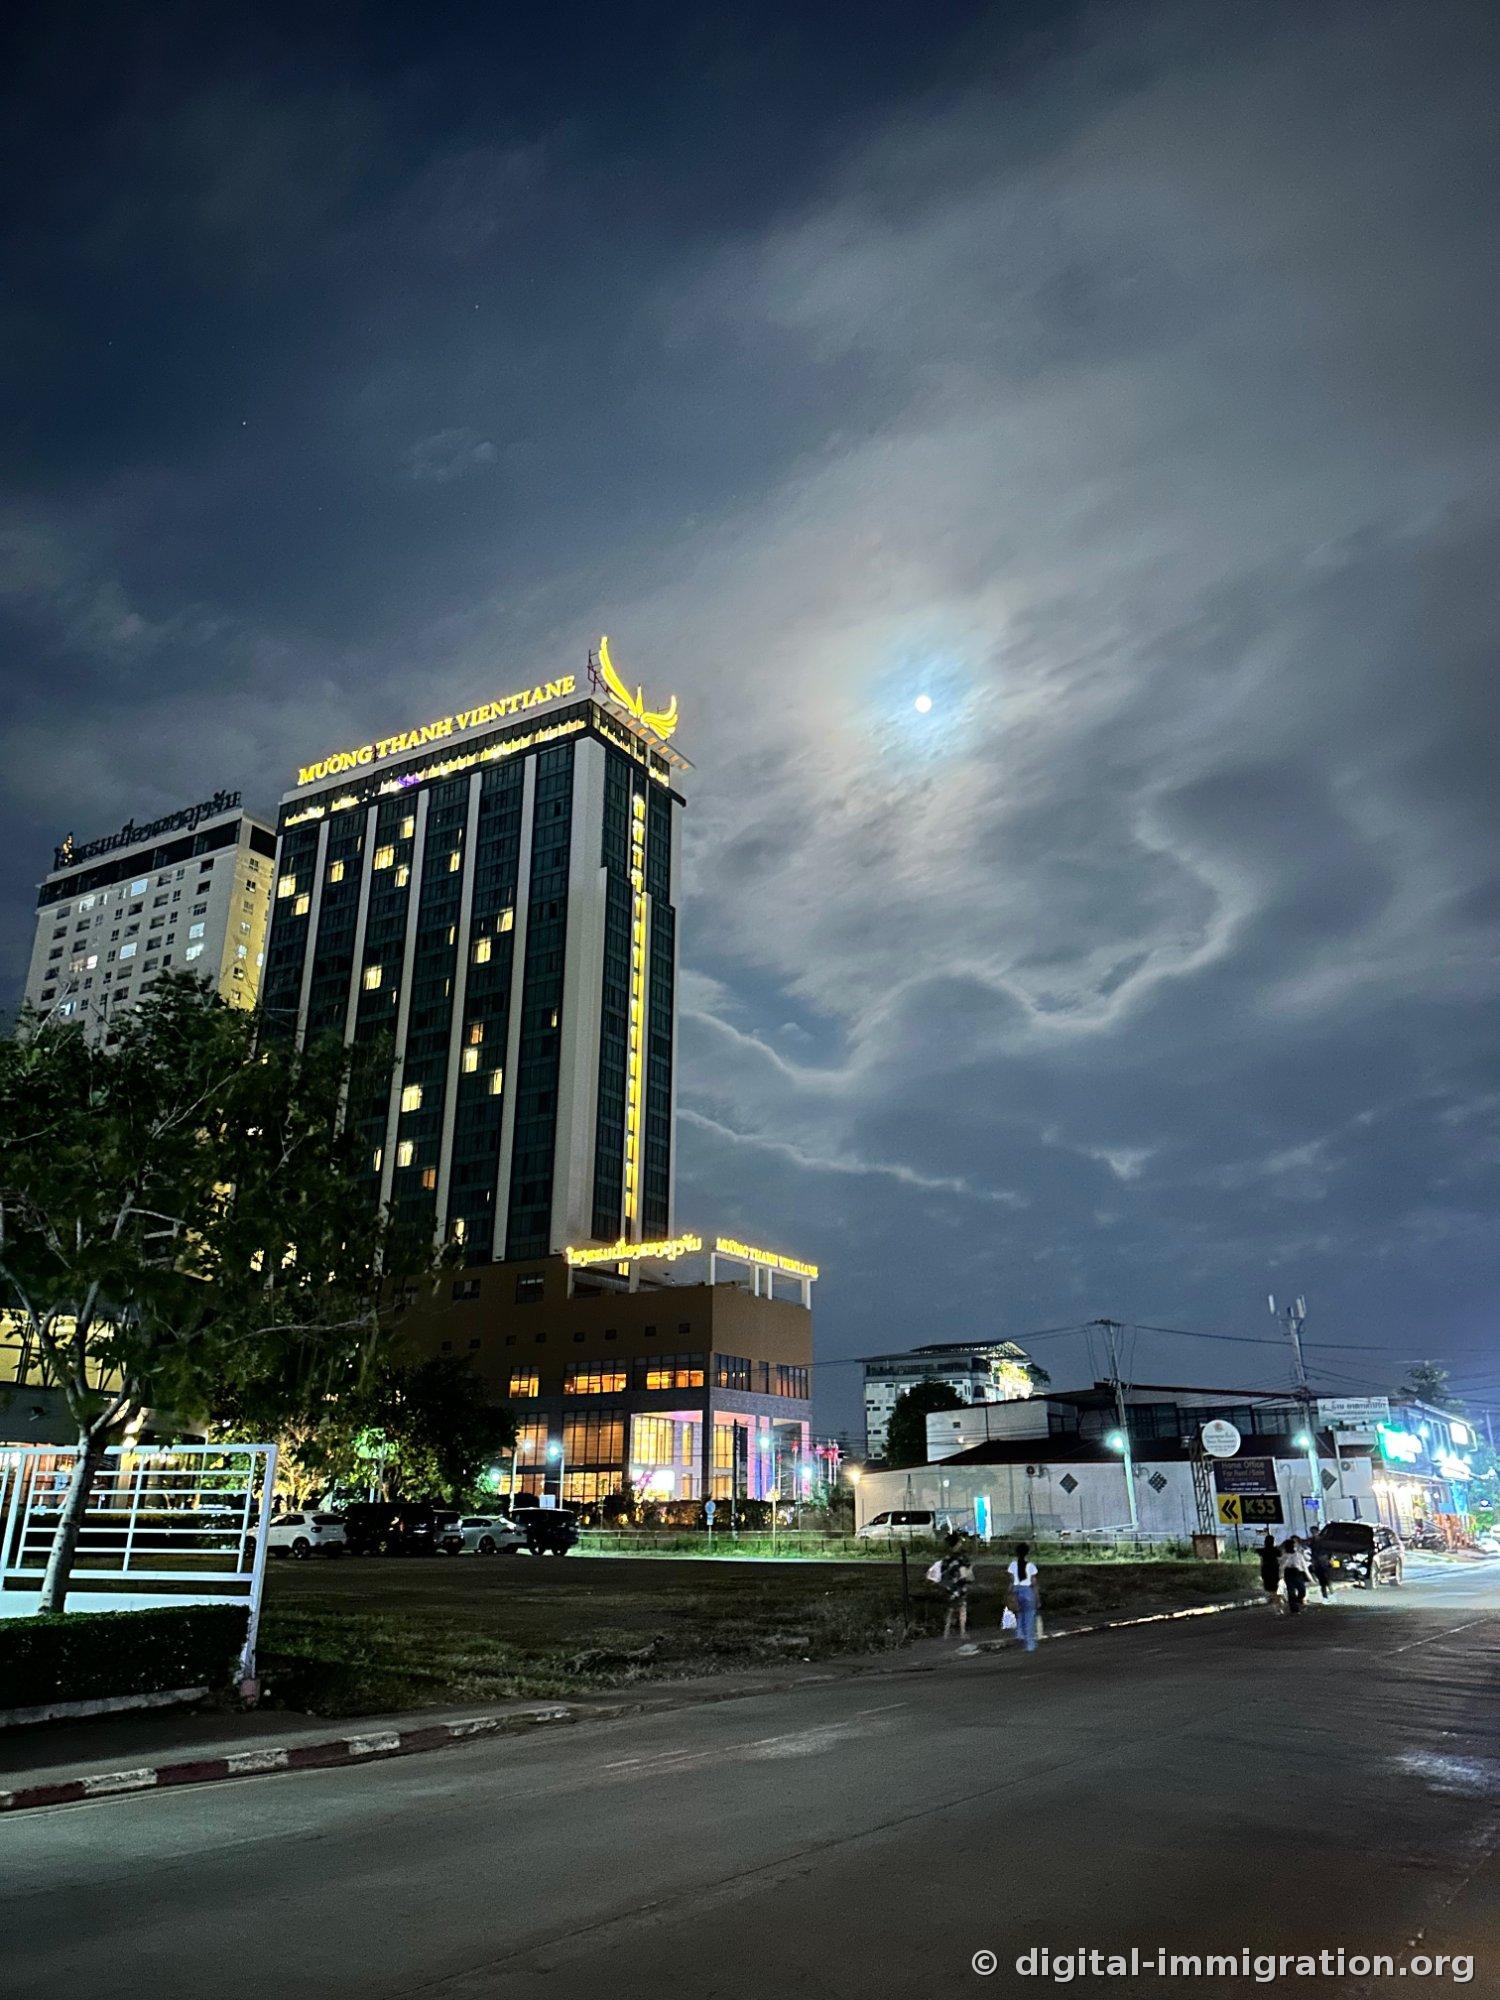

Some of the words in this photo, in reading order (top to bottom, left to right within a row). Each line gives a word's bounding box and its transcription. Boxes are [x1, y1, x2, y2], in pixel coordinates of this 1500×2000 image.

[376, 717, 453, 758] THANH
[456, 675, 575, 731] VIENTIANE
[1243, 1460, 1265, 1470] Office
